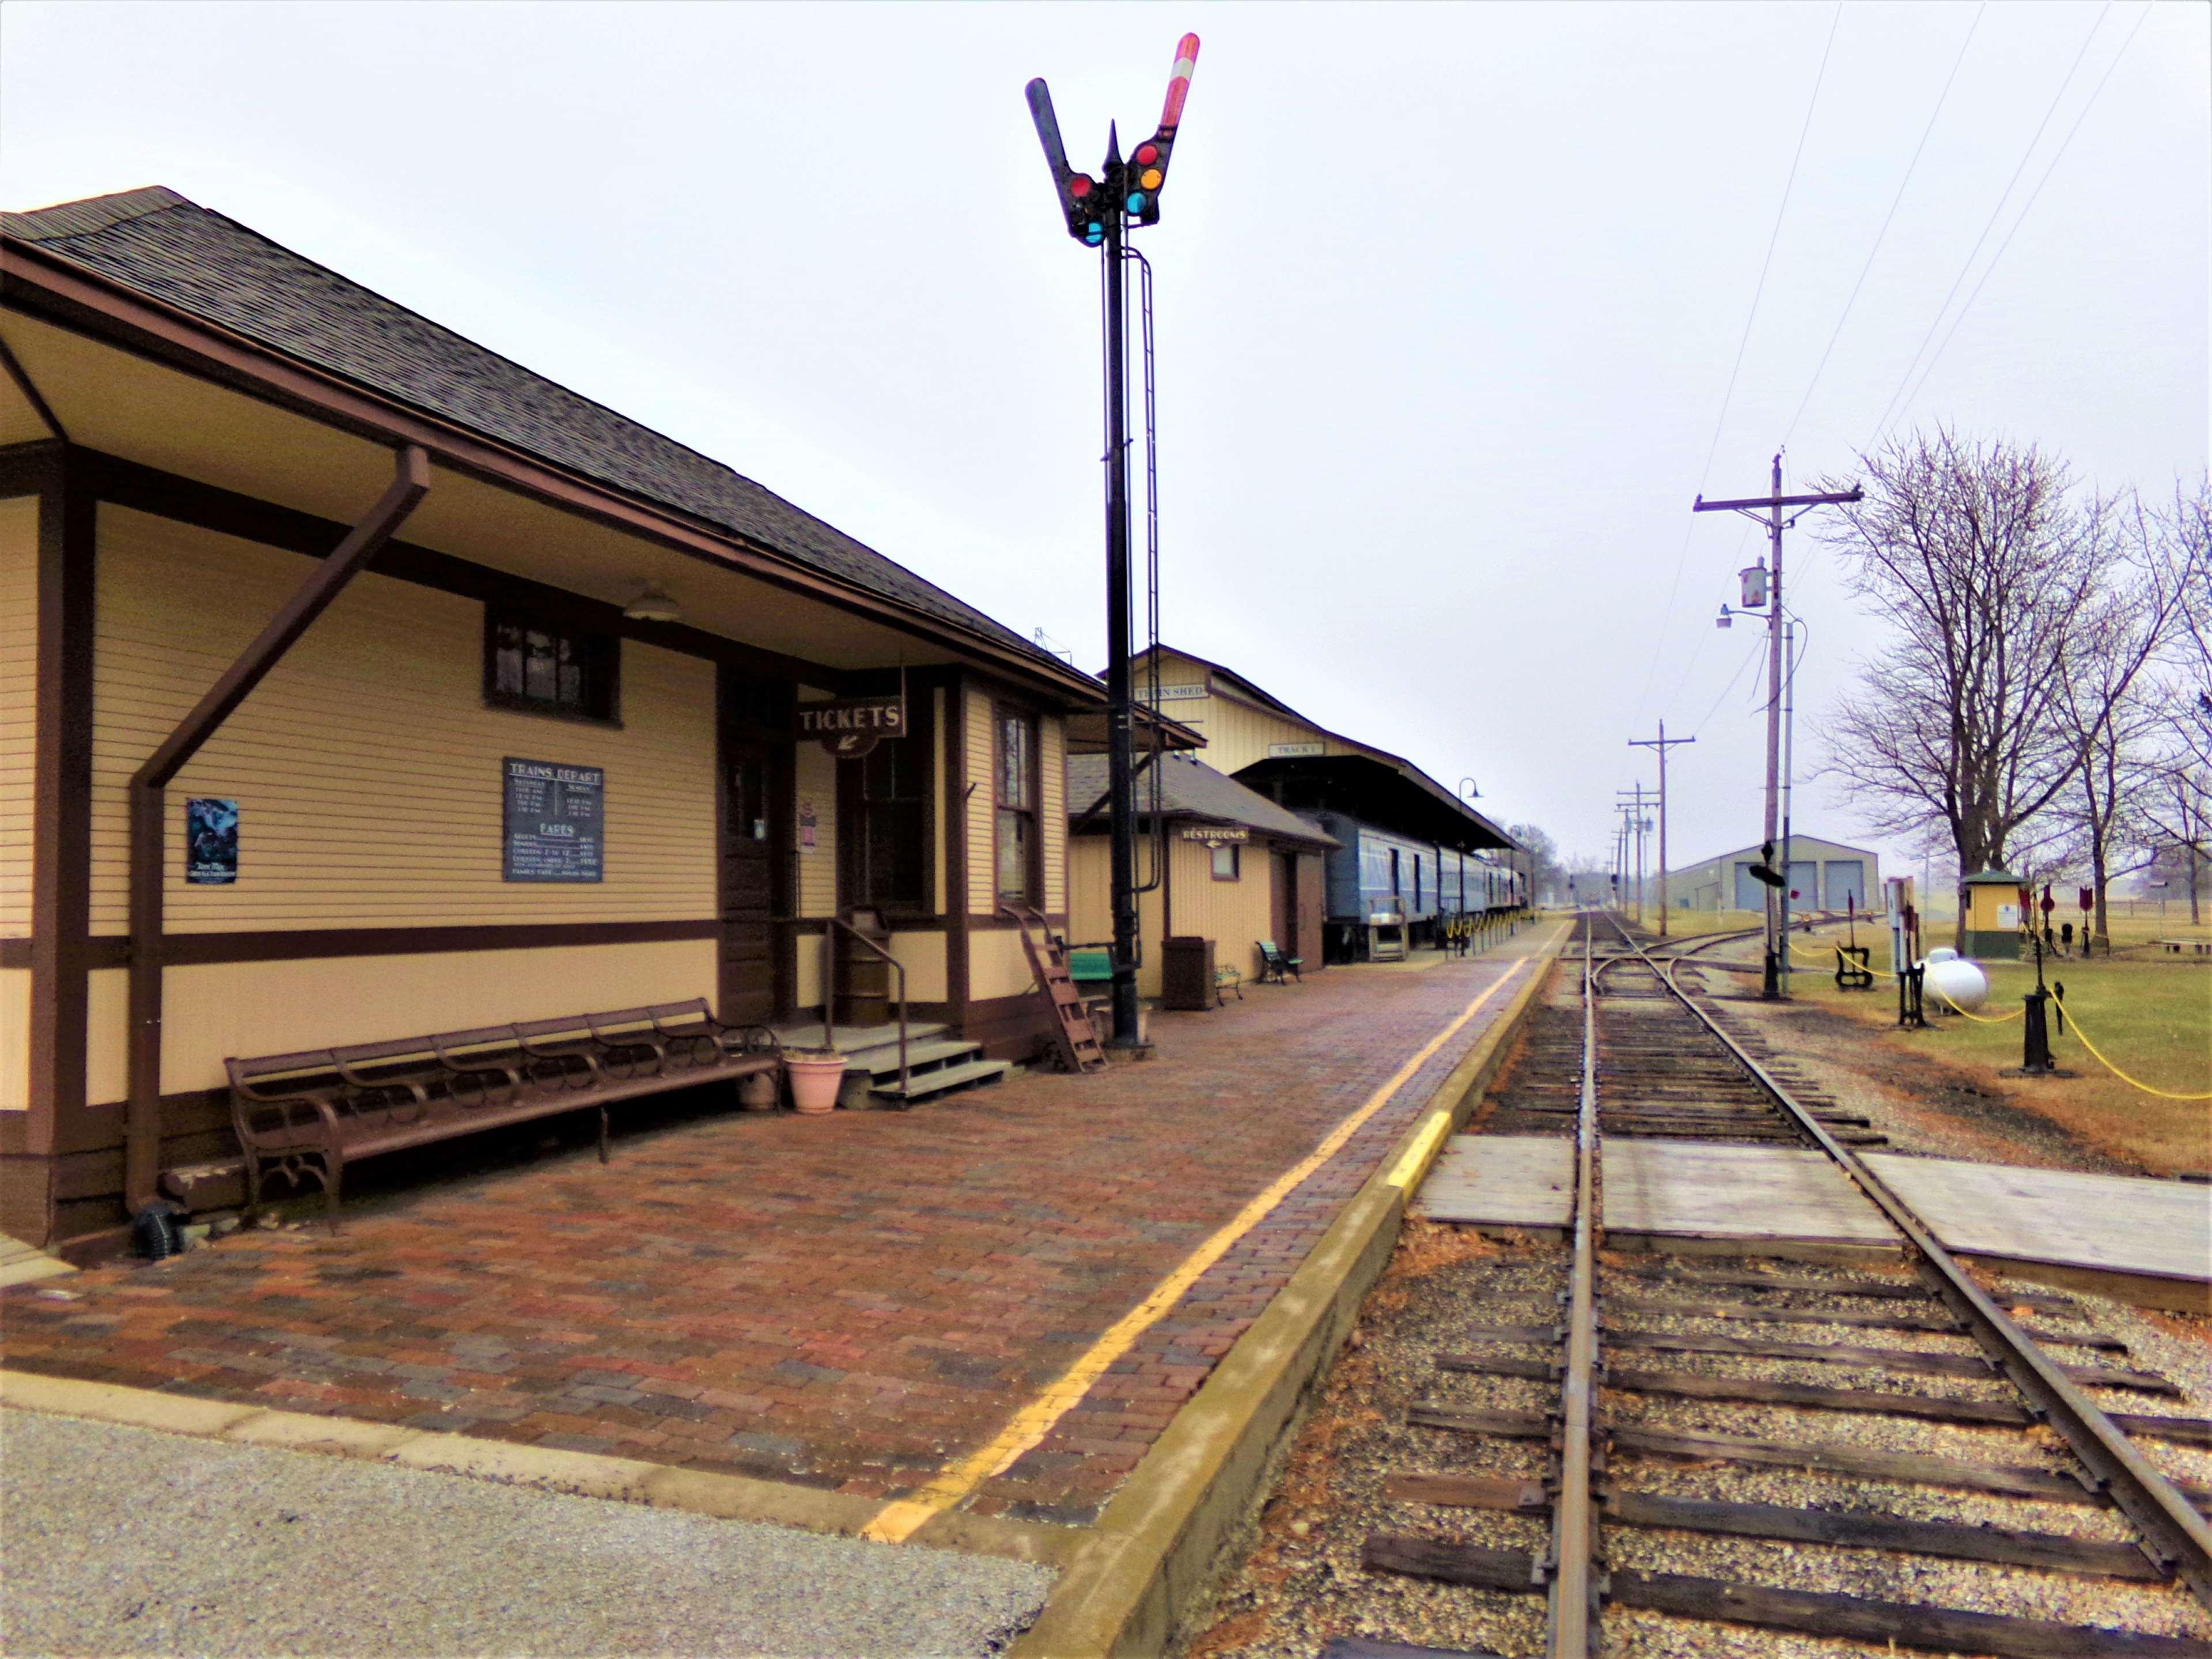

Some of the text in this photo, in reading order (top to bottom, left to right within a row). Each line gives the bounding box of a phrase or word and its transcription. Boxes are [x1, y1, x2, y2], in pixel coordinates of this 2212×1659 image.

[1174, 687, 1202, 695] SHED
[799, 704, 899, 731] TICKETS
[510, 763, 601, 783] TRAINS DEPART
[540, 823, 575, 834] FARES
[1183, 830, 1247, 839] RESTROOMS
